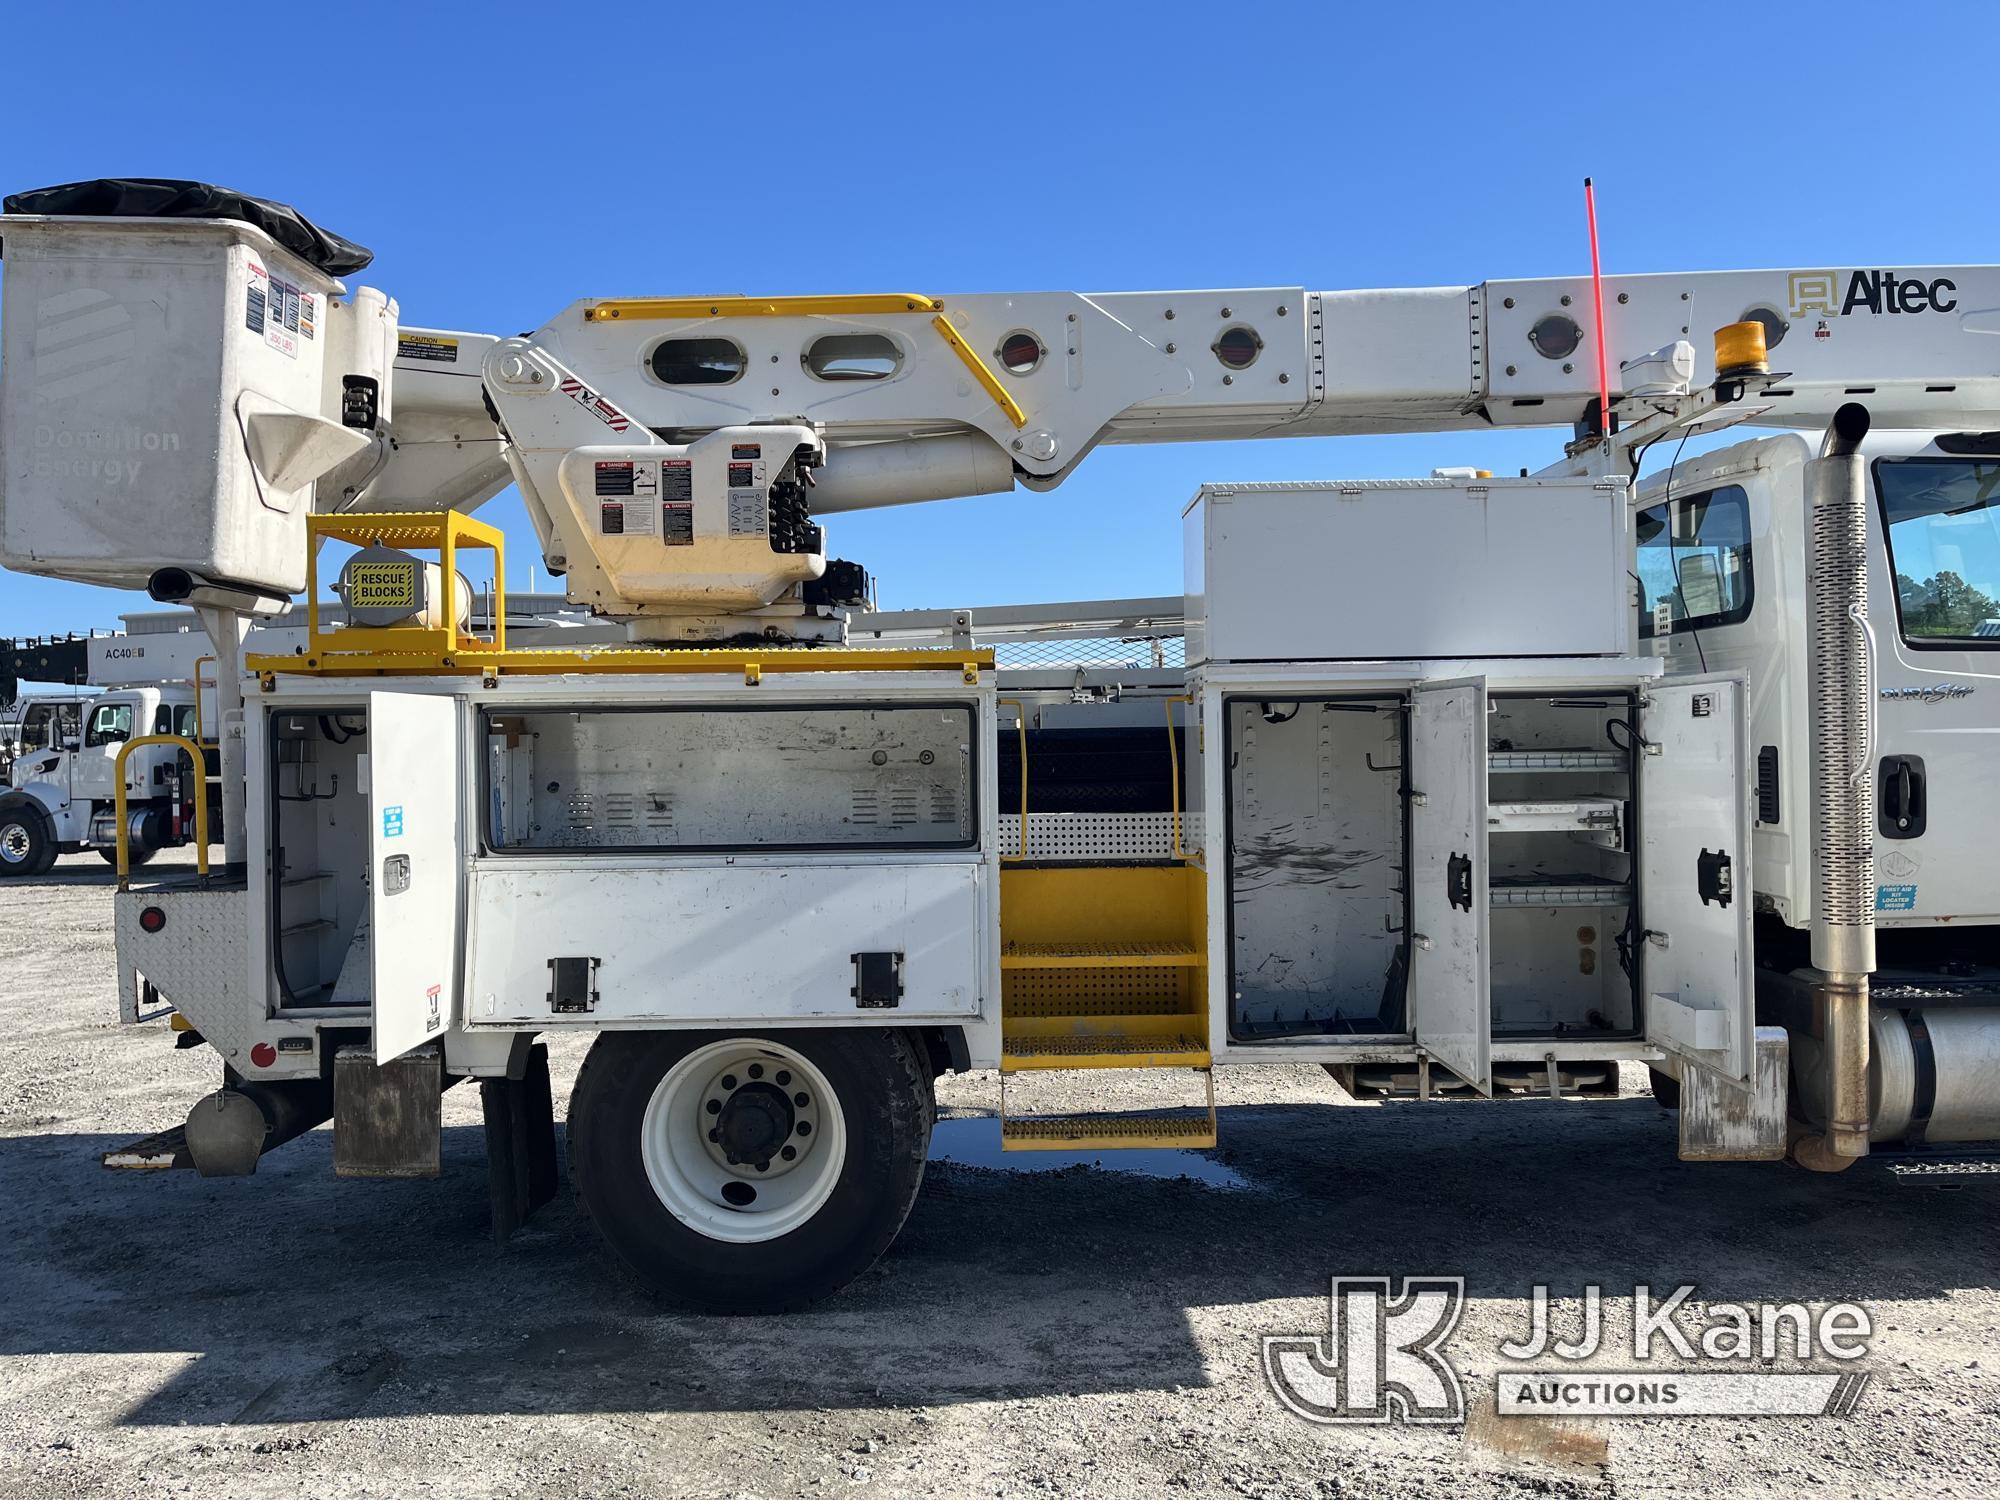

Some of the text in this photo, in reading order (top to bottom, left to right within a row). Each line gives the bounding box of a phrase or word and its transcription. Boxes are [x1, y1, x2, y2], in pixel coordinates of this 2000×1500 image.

[1841, 270, 1956, 316] Altec
[410, 335, 438, 344] CAUTION
[361, 573, 405, 584] RESCUE
[361, 586, 405, 597] BLOCKS
